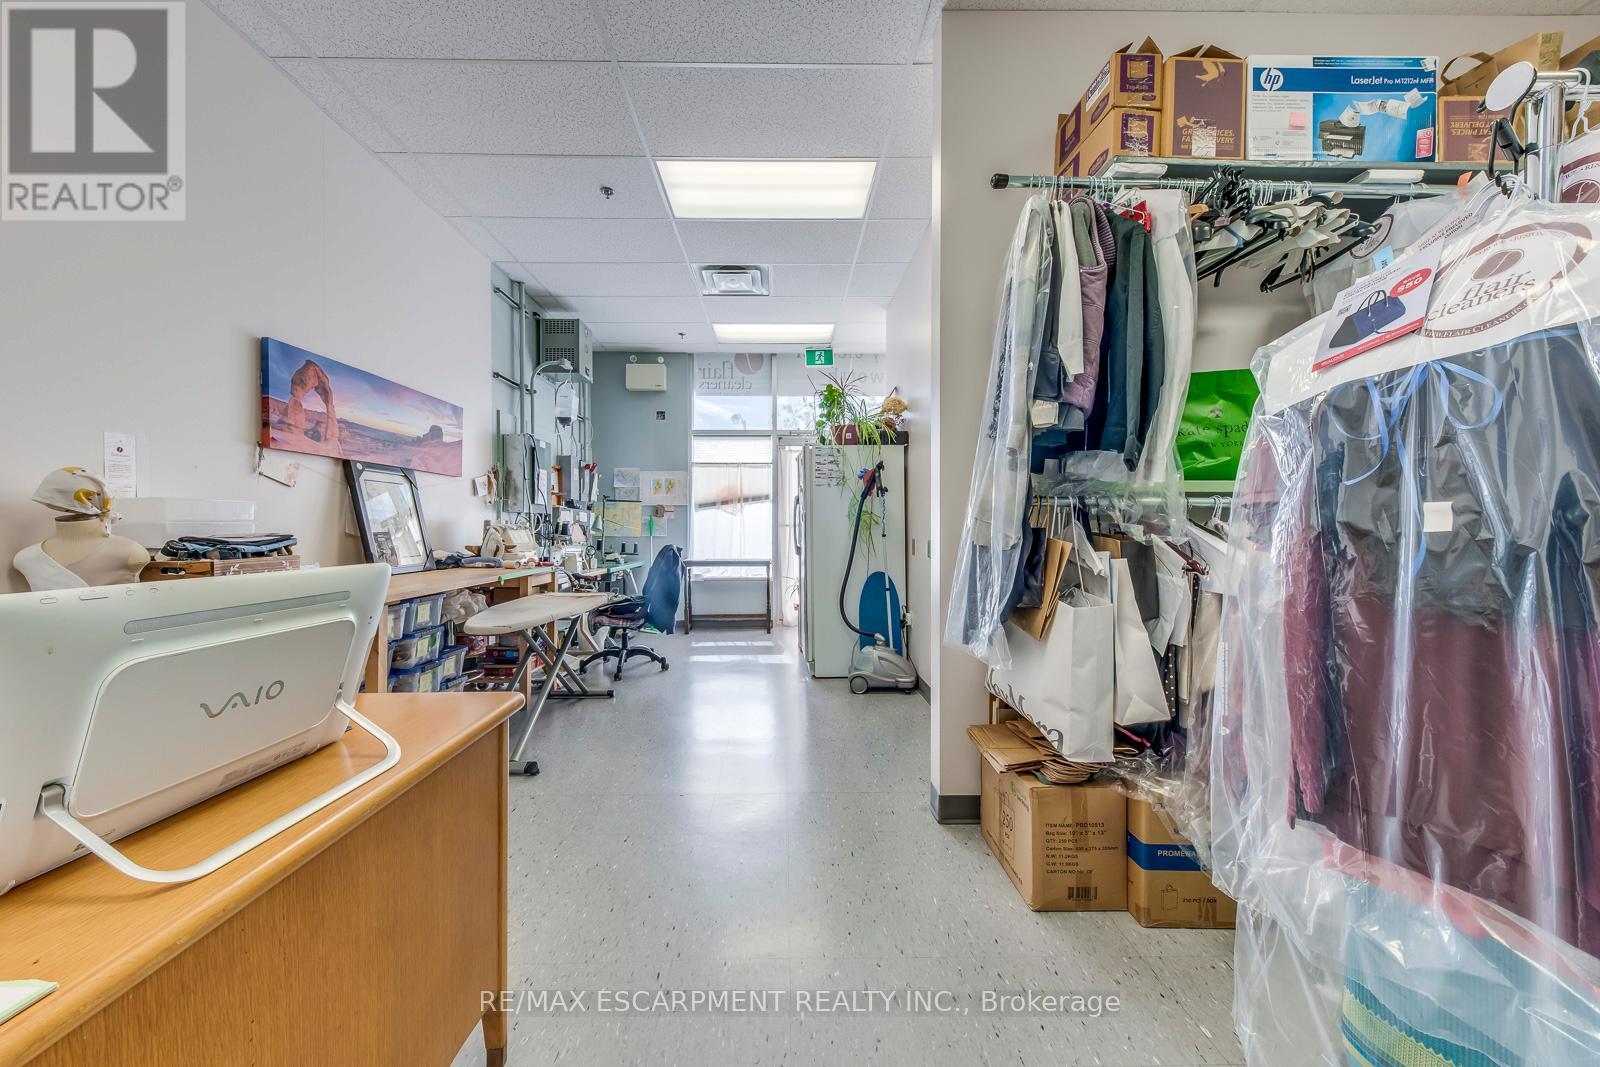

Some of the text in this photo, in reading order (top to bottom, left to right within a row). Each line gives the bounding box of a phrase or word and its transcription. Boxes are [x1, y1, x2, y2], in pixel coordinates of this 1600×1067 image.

[1263, 68, 1281, 91] hp
[1350, 75, 1383, 85] LaserJet
[1402, 273, 1421, 285] SAVE
[1463, 270, 1532, 301] flair
[1427, 278, 1536, 322] cleaners
[1215, 421, 1248, 437] spad
[199, 679, 285, 718] VAIO
[1157, 849, 1197, 857] PROMENA
